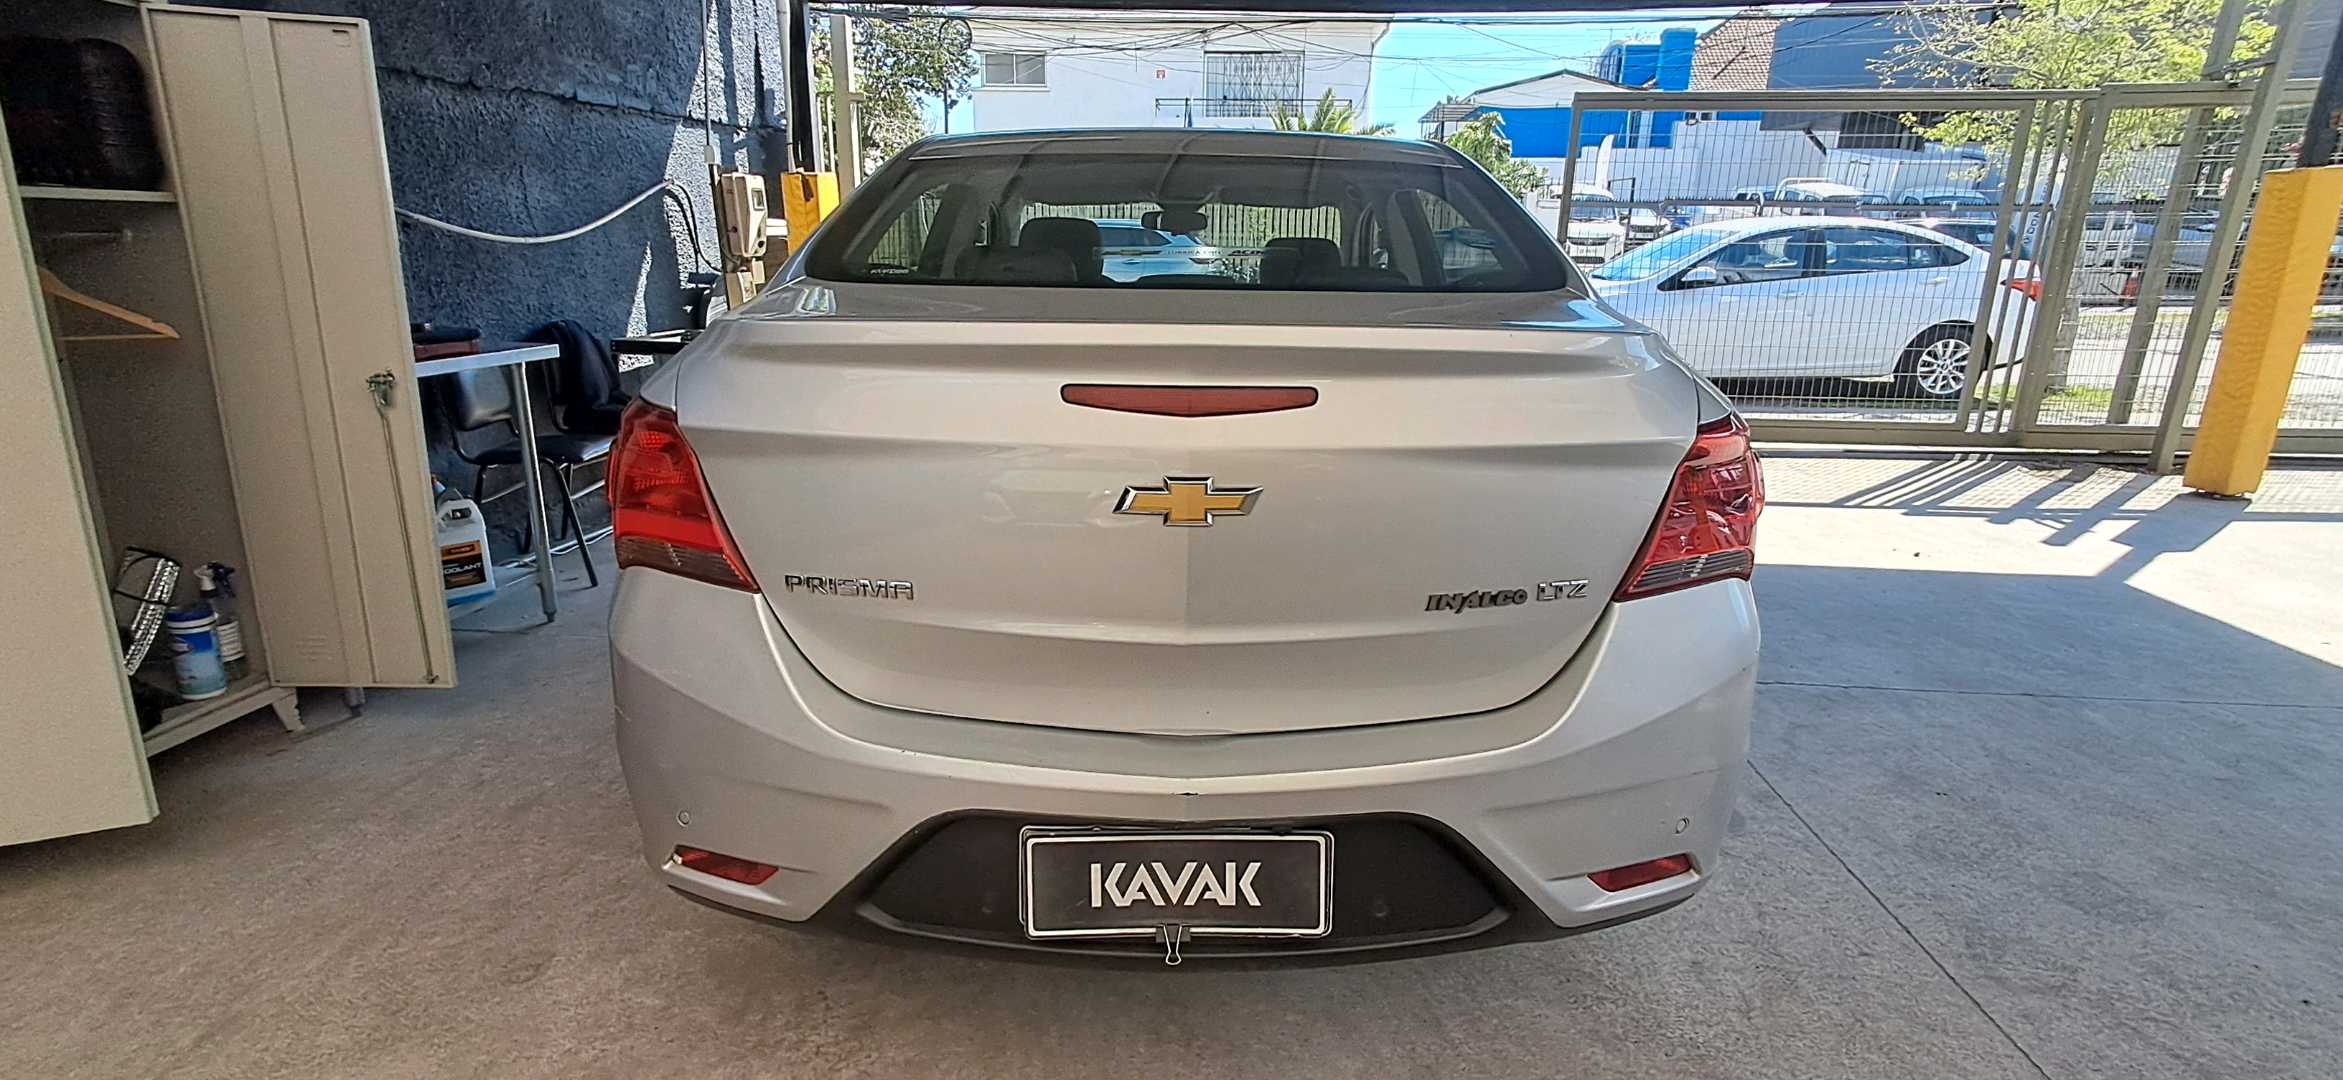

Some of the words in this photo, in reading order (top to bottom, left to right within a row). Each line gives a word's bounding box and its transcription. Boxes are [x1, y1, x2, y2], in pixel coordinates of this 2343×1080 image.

[785, 575, 914, 601] PRISMA
[1536, 579, 1591, 602] LTZ
[1090, 861, 1262, 908] KAVAK
